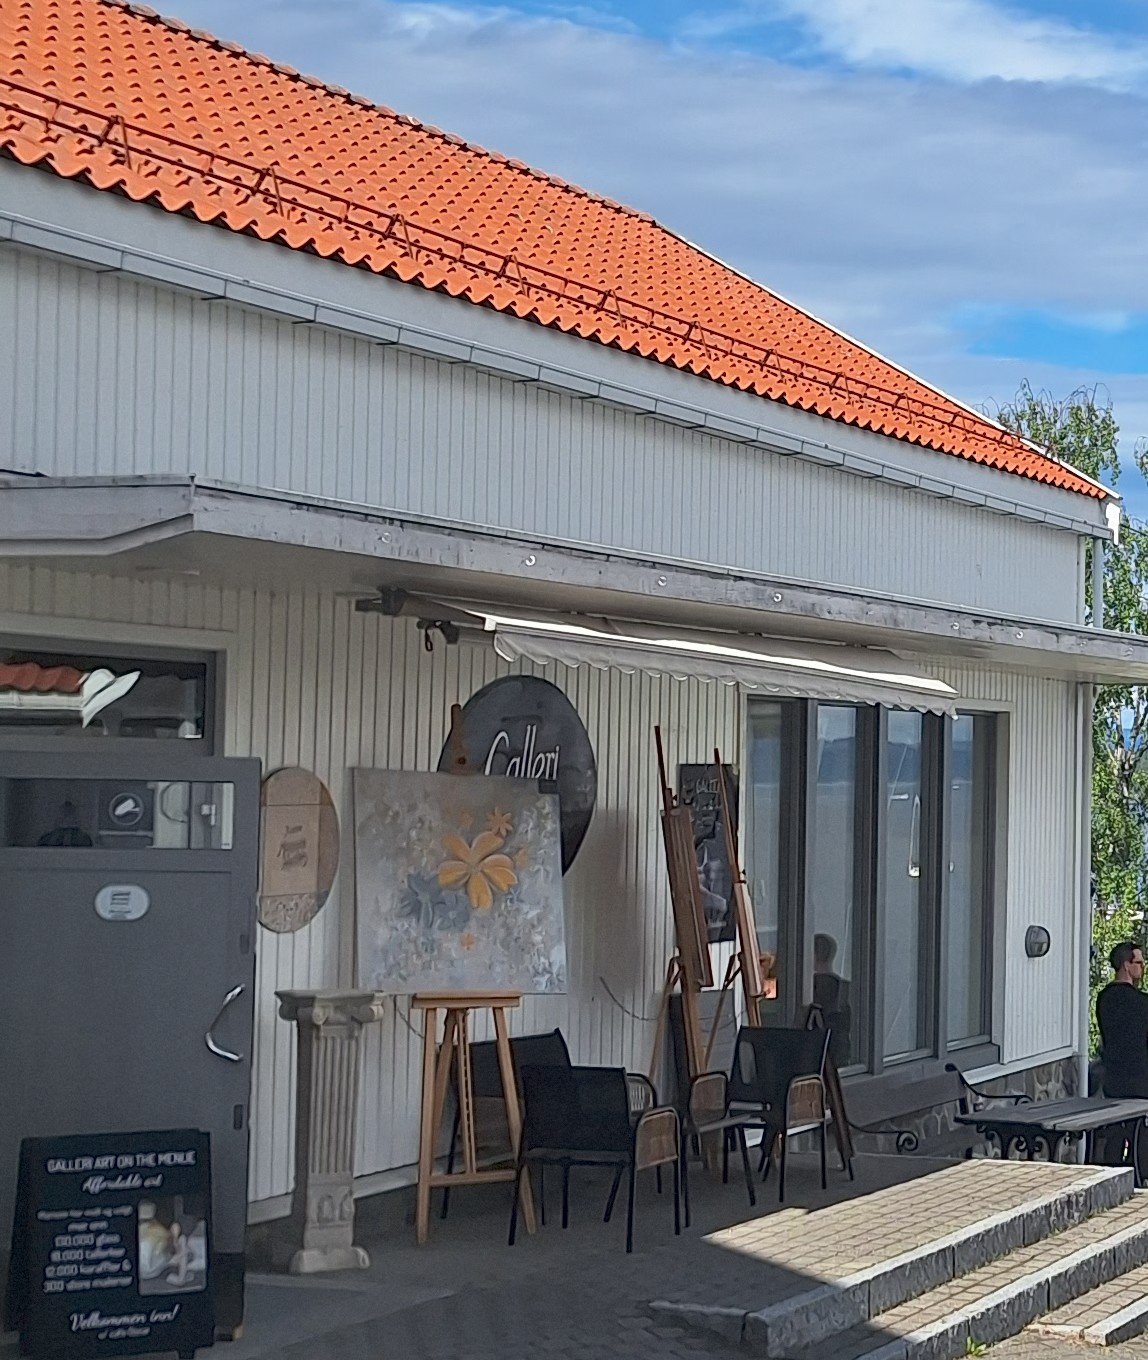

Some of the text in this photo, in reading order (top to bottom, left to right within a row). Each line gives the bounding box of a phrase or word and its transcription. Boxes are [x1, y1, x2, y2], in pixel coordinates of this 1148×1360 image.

[47, 1158, 94, 1173] GALLERI
[94, 1155, 115, 1170] ART
[117, 1154, 134, 1168] ON
[136, 1152, 156, 1167] THE
